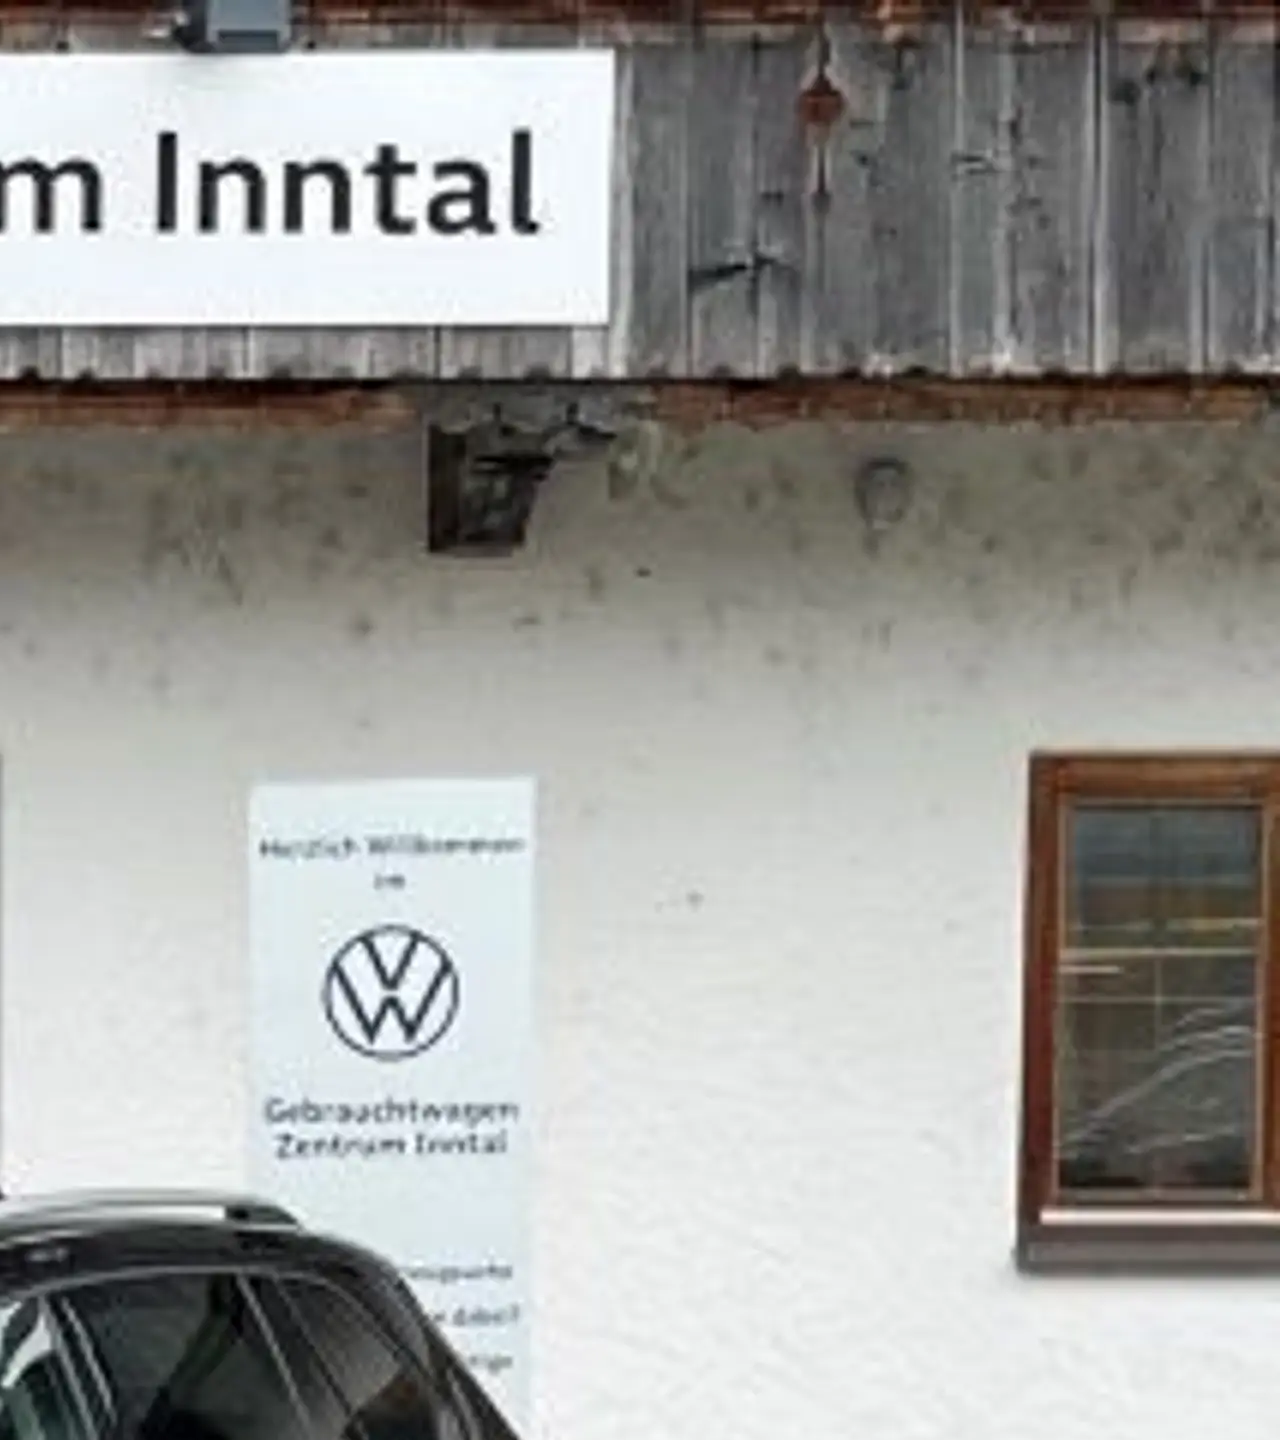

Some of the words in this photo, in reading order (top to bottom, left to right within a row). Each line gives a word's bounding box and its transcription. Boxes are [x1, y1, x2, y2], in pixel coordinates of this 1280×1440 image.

[154, 129, 541, 236] Inntal
[263, 1096, 521, 1132] Gebrauchtwagen
[275, 1131, 408, 1161] Zentrum
[414, 1129, 508, 1157] Inntal
